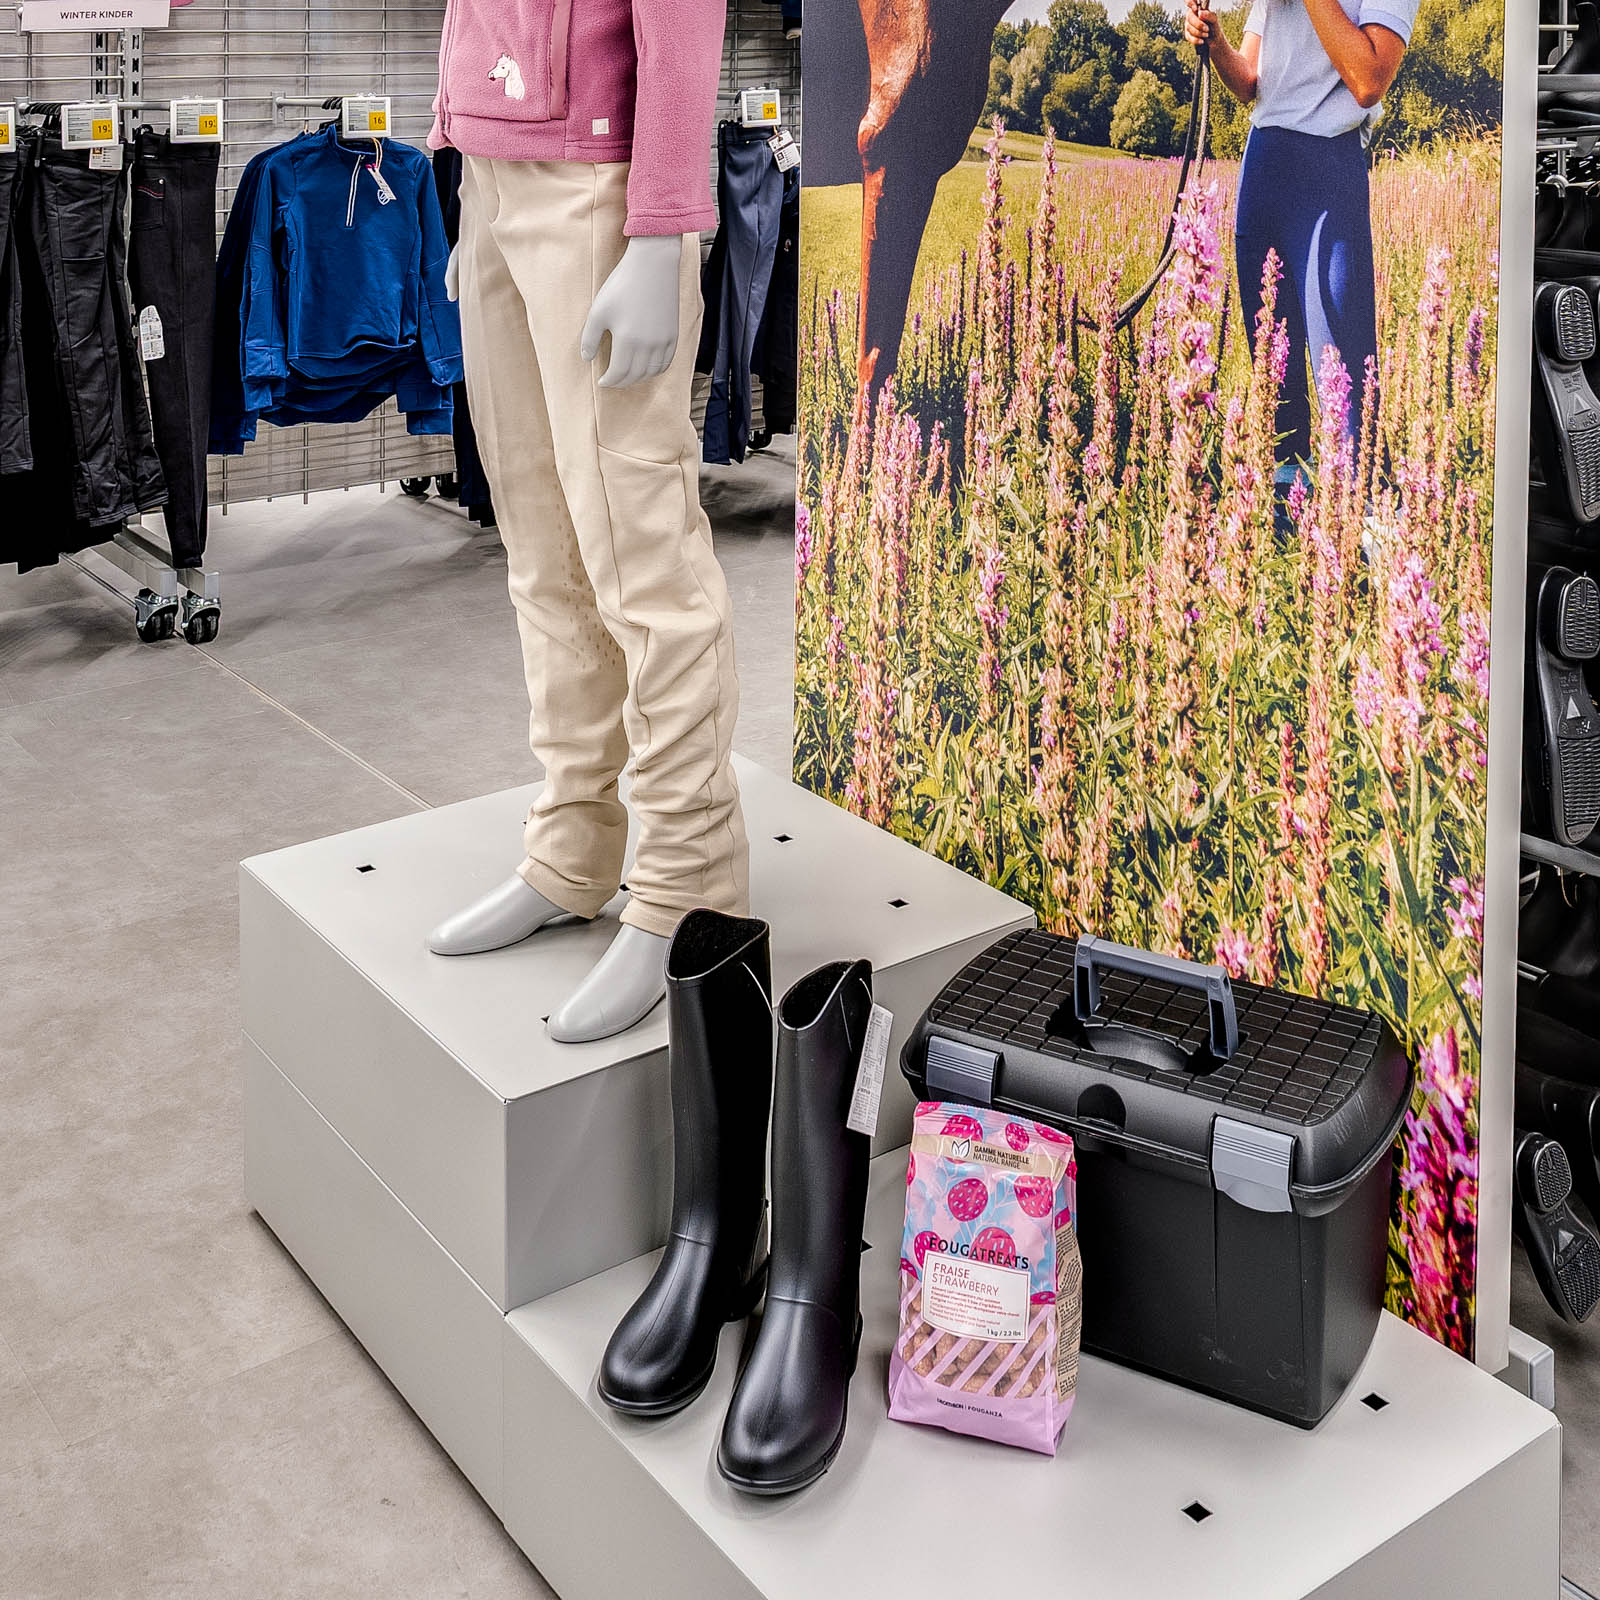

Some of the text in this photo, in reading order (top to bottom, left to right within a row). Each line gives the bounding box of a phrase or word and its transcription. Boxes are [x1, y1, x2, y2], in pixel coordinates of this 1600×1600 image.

[60, 10, 134, 20] WINTER KINDER
[972, 1152, 1021, 1170] NATURAL RANGE
[974, 1145, 1030, 1165] GAMME NATURELLE
[929, 1236, 1029, 1270] FOUGATREATS
[933, 1262, 971, 1279] FRAISE
[931, 1272, 1000, 1297] STRAWBERRY
